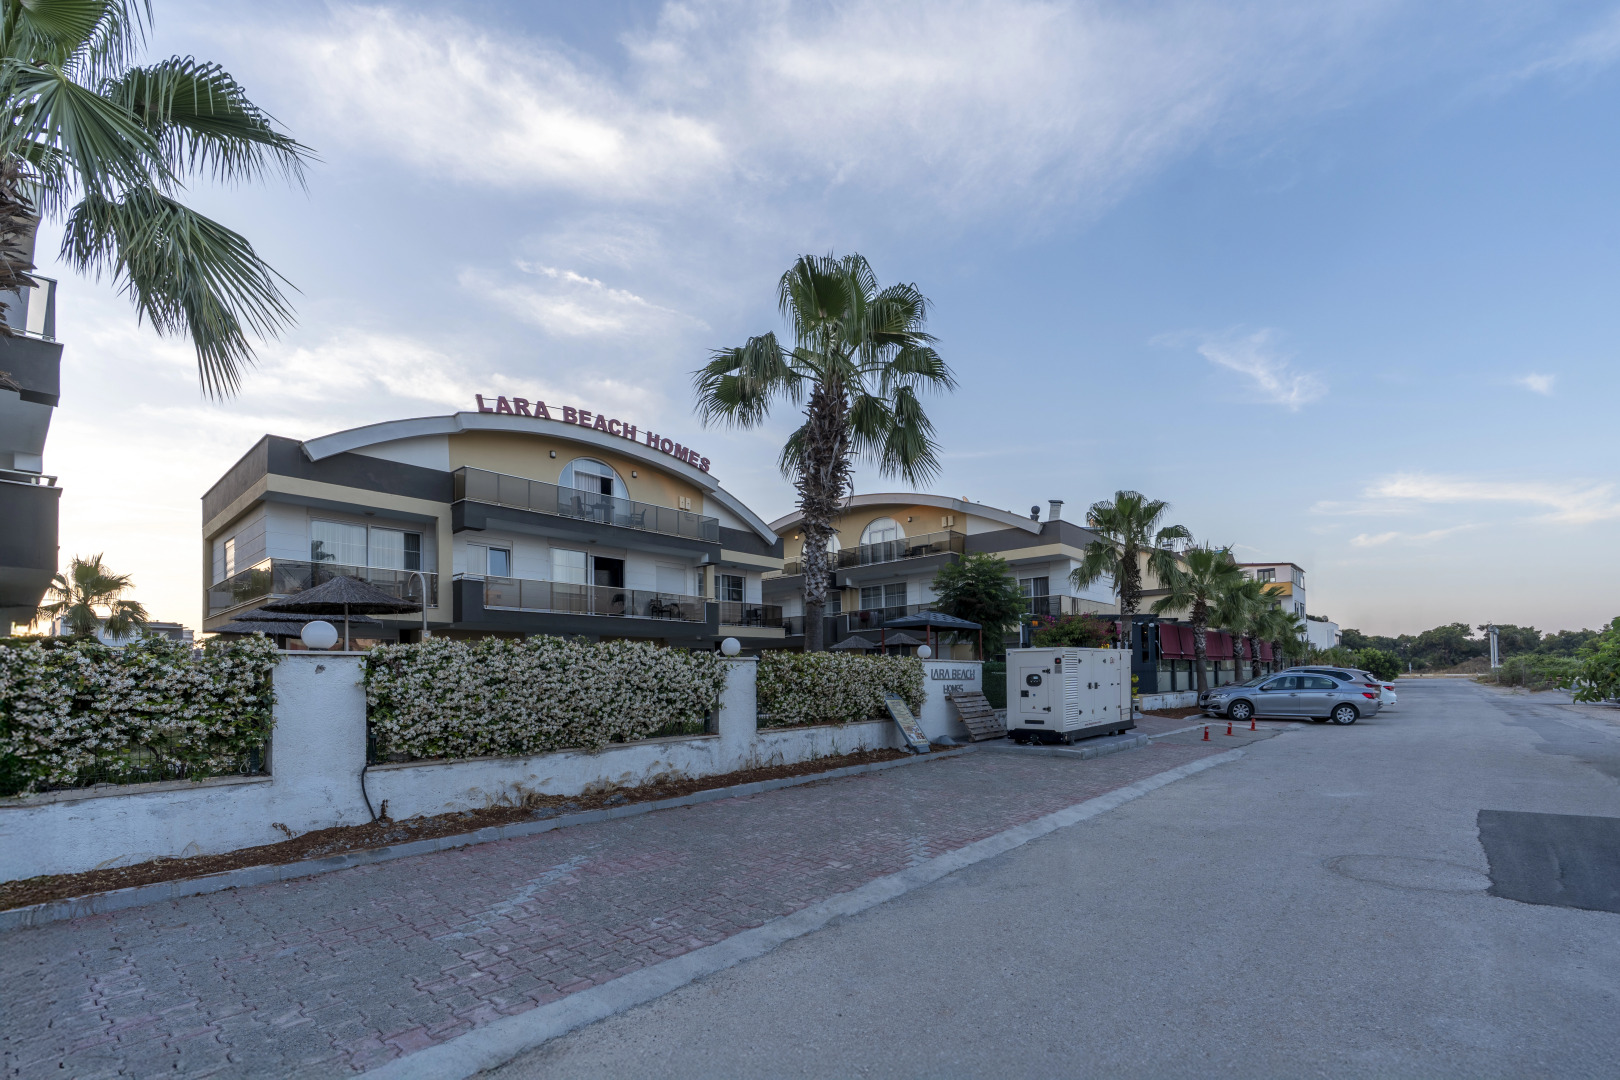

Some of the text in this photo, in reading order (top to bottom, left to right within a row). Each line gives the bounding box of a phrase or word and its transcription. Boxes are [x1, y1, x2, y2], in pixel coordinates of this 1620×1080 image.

[475, 394, 710, 472] LARA BEACH HOMES
[930, 669, 975, 680] LARA BEACH
[943, 684, 963, 693] HOMES
